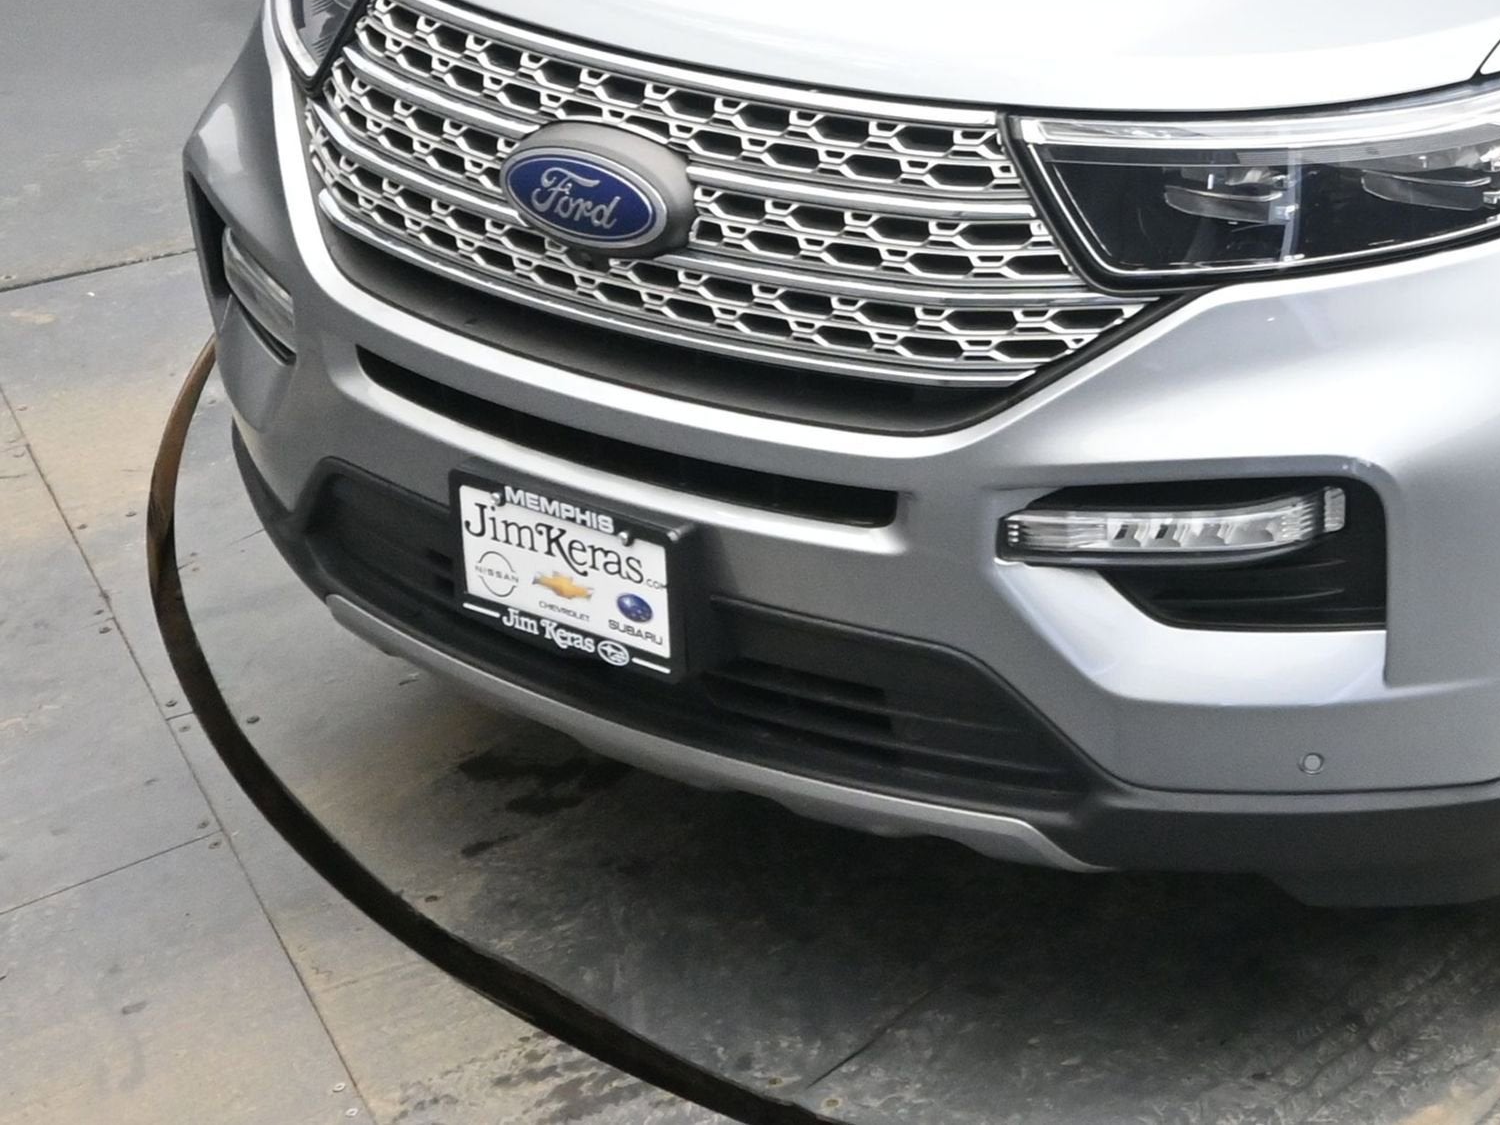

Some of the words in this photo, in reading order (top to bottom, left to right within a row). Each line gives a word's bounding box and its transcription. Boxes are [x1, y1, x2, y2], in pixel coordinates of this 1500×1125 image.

[531, 166, 621, 229] Ford
[504, 485, 615, 534] MEMPHIS
[502, 607, 540, 635] Jim
[539, 618, 596, 653] Keras
[538, 600, 590, 622] CHEVROLET
[608, 618, 664, 646] SUBARU
